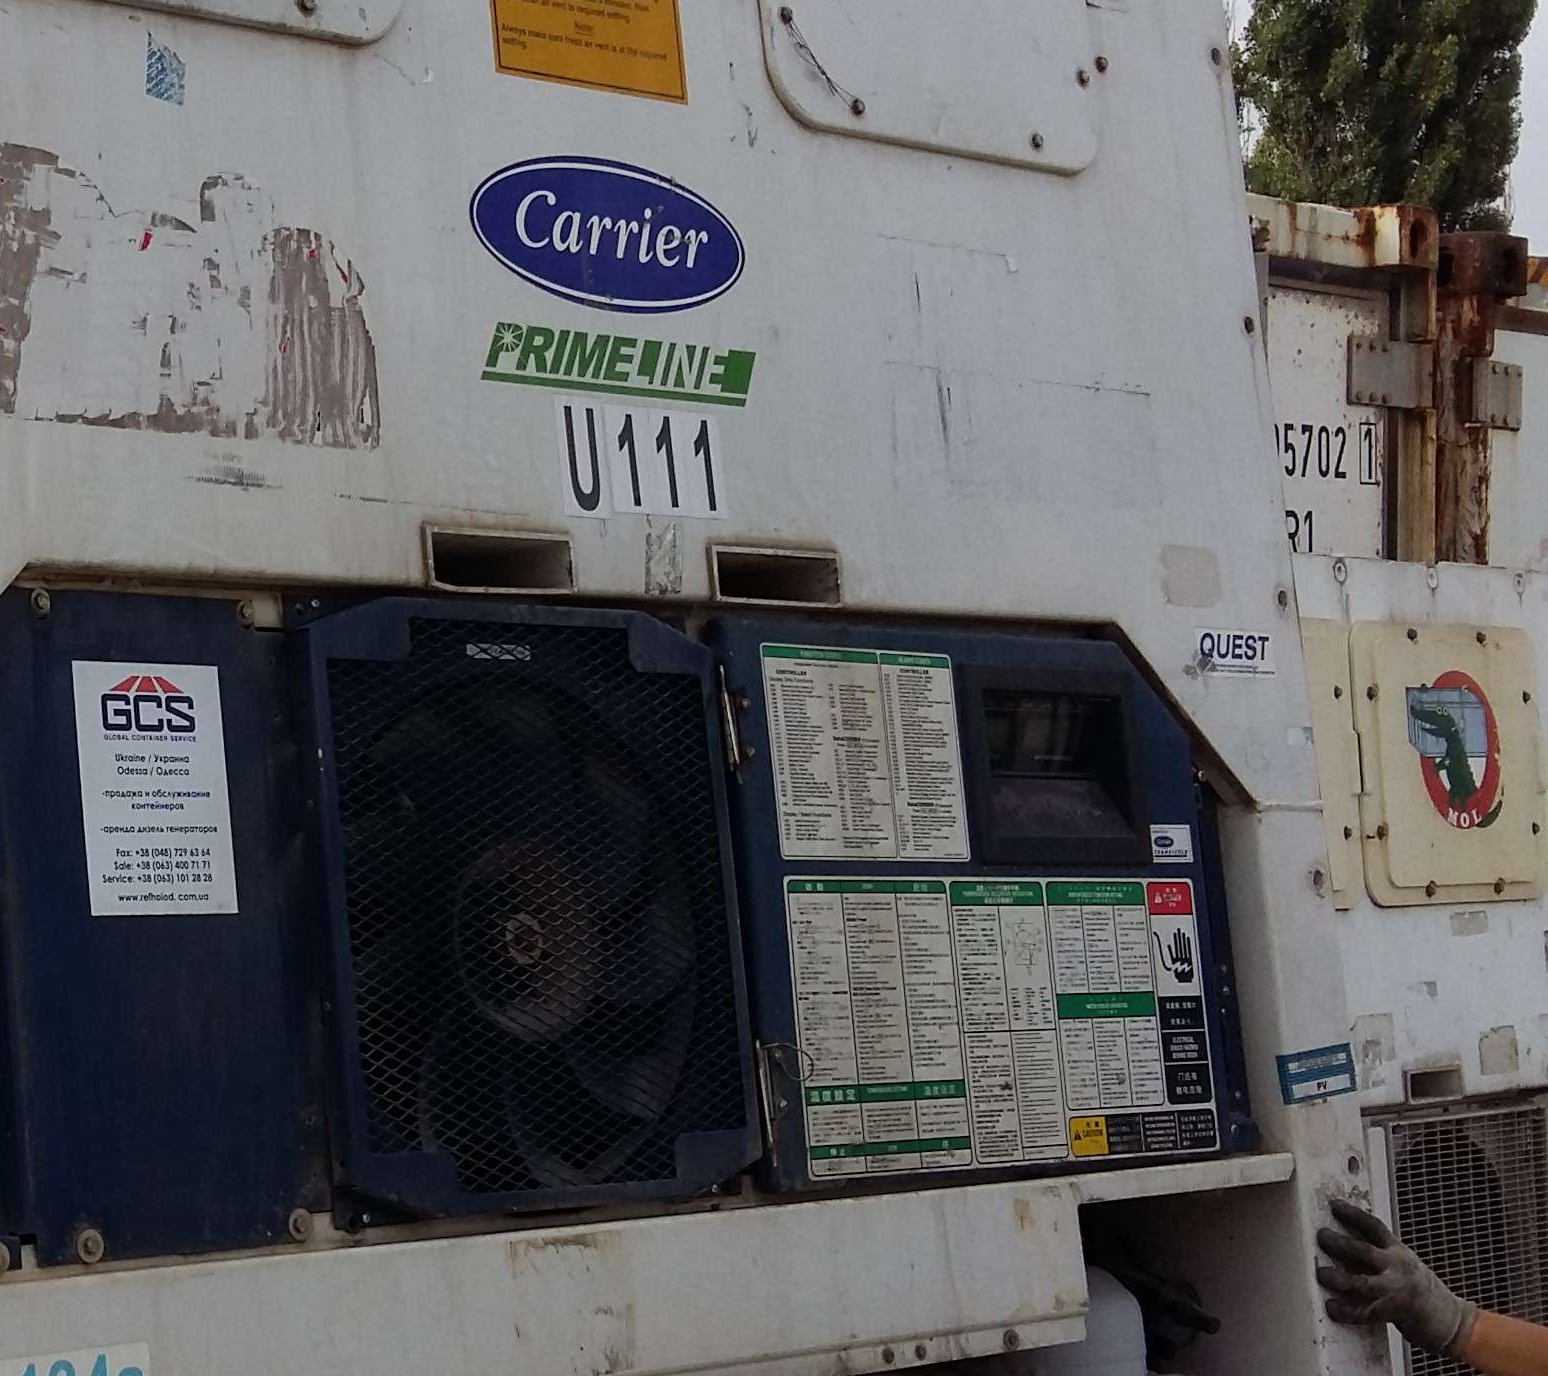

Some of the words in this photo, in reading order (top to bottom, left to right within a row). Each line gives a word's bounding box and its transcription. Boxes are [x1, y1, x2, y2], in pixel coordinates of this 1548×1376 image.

[552, 0, 567, 10] vent
[568, 4, 575, 12] to
[576, 4, 605, 19] required
[501, 23, 528, 37] Always
[565, 33, 583, 46] fresh
[584, 38, 594, 48] air
[594, 40, 610, 51] vent
[515, 190, 709, 269] Carrier
[485, 321, 756, 395] PRIMELINE
[563, 405, 717, 512] U111
[1274, 423, 1347, 479] 5702
[1199, 632, 1270, 661] QUEST
[101, 693, 196, 733] GCS
[103, 734, 129, 742] GLOBAL
[132, 734, 168, 742] CONTAINER
[170, 735, 197, 743] SERVICE
[115, 753, 146, 763] Ukraine
[153, 754, 190, 765] Украина
[117, 766, 148, 775] Odessa
[156, 766, 190, 776] Одесса
[131, 801, 185, 812] контейнеров
[1446, 806, 1483, 829] MOL
[166, 827, 219, 835] генераторов
[116, 848, 133, 857] Fax:
[135, 848, 150, 857] +38
[114, 861, 134, 871] Sale:
[136, 861, 151, 870] +38
[190, 860, 200, 870] 71
[202, 860, 211, 870] 71
[102, 874, 136, 884] Service:
[176, 873, 190, 883] 101
